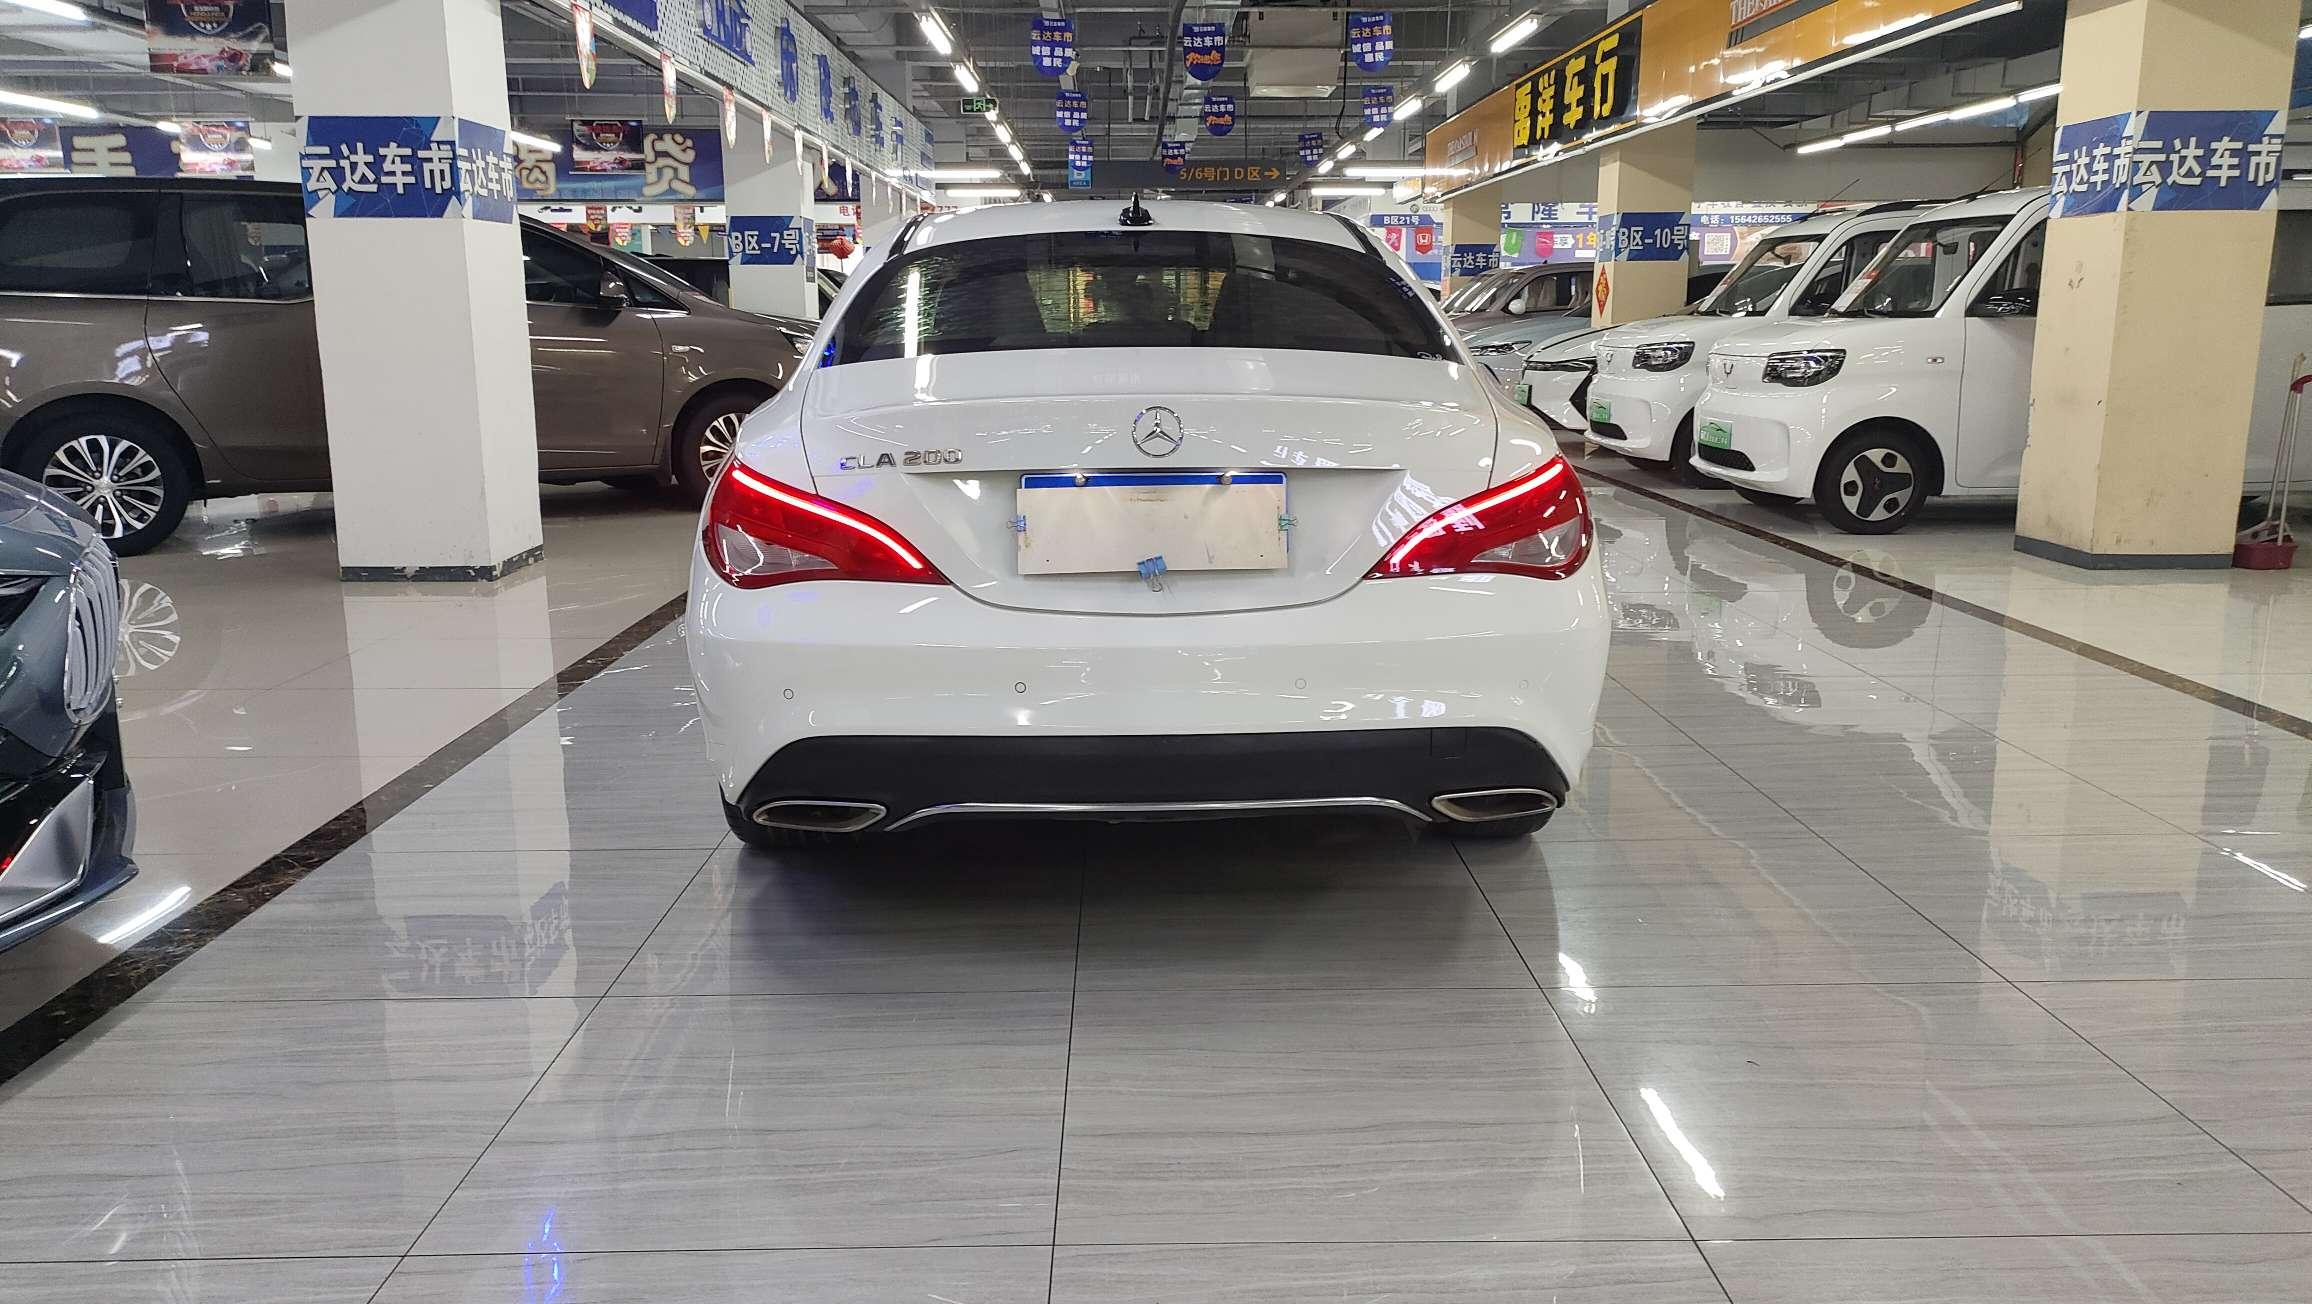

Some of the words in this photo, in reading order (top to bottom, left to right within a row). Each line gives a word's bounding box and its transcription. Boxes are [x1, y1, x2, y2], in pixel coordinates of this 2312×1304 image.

[1031, 31, 1073, 42] 云达车市
[1352, 25, 1392, 38] 云达车市
[1183, 36, 1224, 47] 云达车市
[1352, 43, 1372, 53] 诚信
[1031, 46, 1051, 56] 诚信
[1204, 104, 1234, 113] 云达车市
[301, 142, 454, 195] 云达车市
[2052, 136, 2133, 195] 云达车市
[2132, 136, 2283, 187] 云达车市
[457, 147, 514, 202] 云达车市
[1383, 215, 1421, 225] B区21号
[729, 228, 800, 255] B区-7号
[1618, 225, 1688, 250] B区-10号
[1450, 252, 1500, 269] 云达车市
[840, 452, 896, 471] CLA
[903, 448, 963, 467] 200
